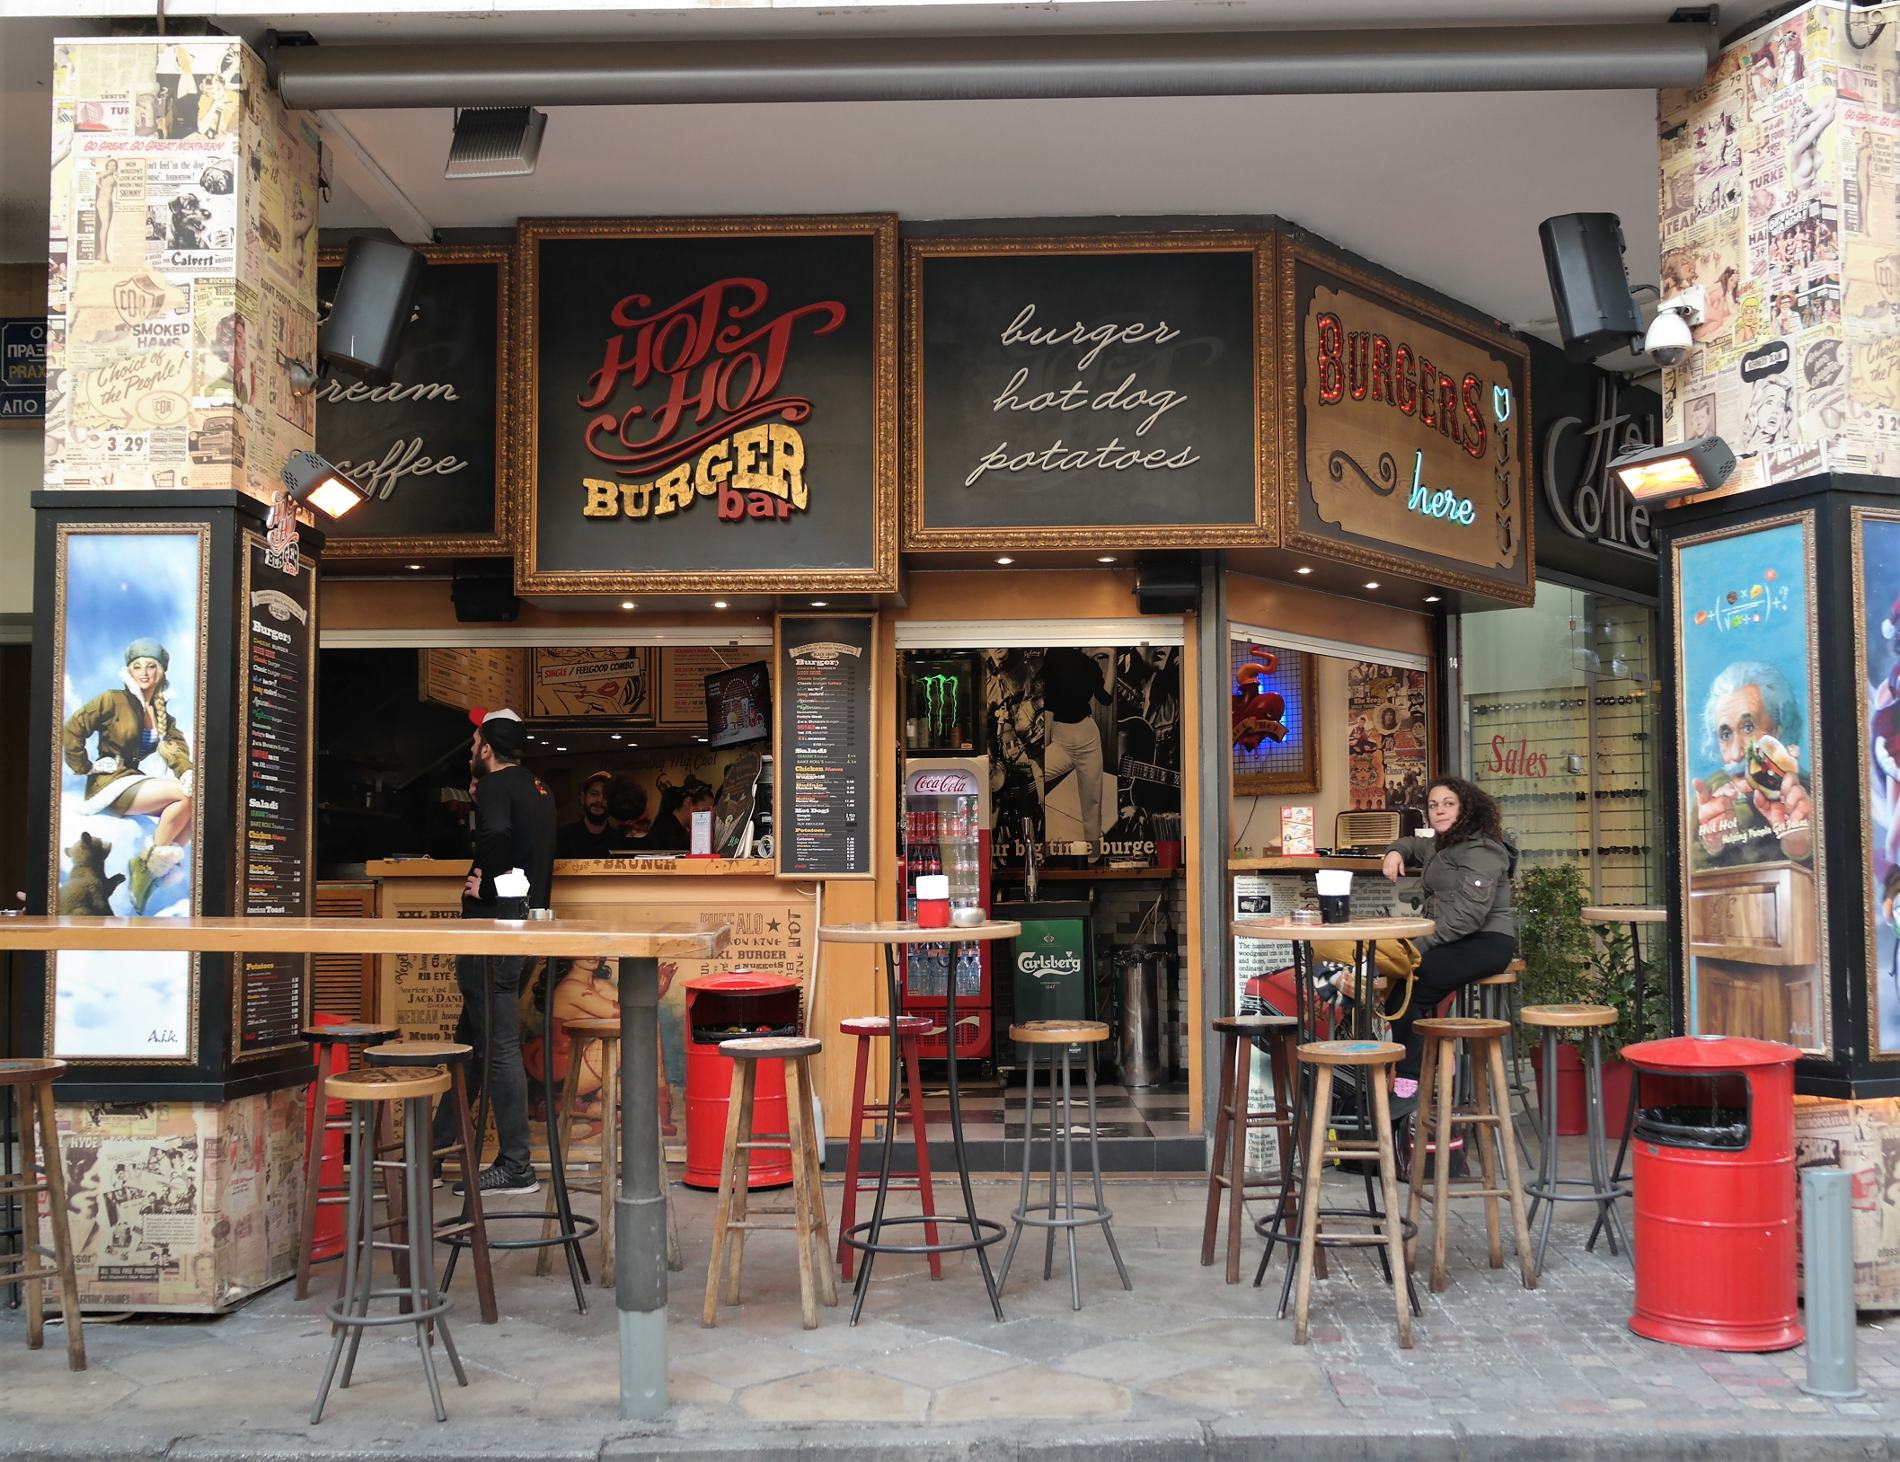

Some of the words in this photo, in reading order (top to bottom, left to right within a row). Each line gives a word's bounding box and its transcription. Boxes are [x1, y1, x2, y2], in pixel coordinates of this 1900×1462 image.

[84, 142, 98, 151] GO
[172, 251, 213, 265] Calvert
[132, 323, 190, 336] SMOKED
[1000, 303, 1180, 371] burger
[576, 277, 769, 408] HOT
[97, 355, 146, 388] Choice
[151, 349, 165, 363] of
[619, 300, 847, 449] HOT
[101, 386, 122, 405] the
[124, 358, 185, 399] People!
[1316, 312, 1488, 459] BURGERS
[2, 399, 38, 413] ΑΠΟ
[993, 367, 1088, 412] hot
[1091, 373, 1187, 437] dog
[582, 422, 808, 518] BURGER
[964, 437, 1200, 487] potatoes
[1408, 448, 1476, 526] here
[717, 480, 798, 521] bar
[544, 668, 567, 678] SINGLE
[610, 661, 635, 671] COMBO
[1449, 658, 1458, 669] 14
[1487, 735, 1549, 778] Sales
[1015, 838, 1044, 861] bg
[1099, 833, 1157, 859] burge
[603, 859, 677, 870] BRUNCH
[397, 911, 427, 919] XXL
[737, 950, 786, 960] BURGER
[1018, 951, 1081, 974] Carlsberg
[408, 994, 434, 1003] JACK
[397, 1010, 438, 1024] MEXICAN
[70, 1136, 99, 1148] HYDE
